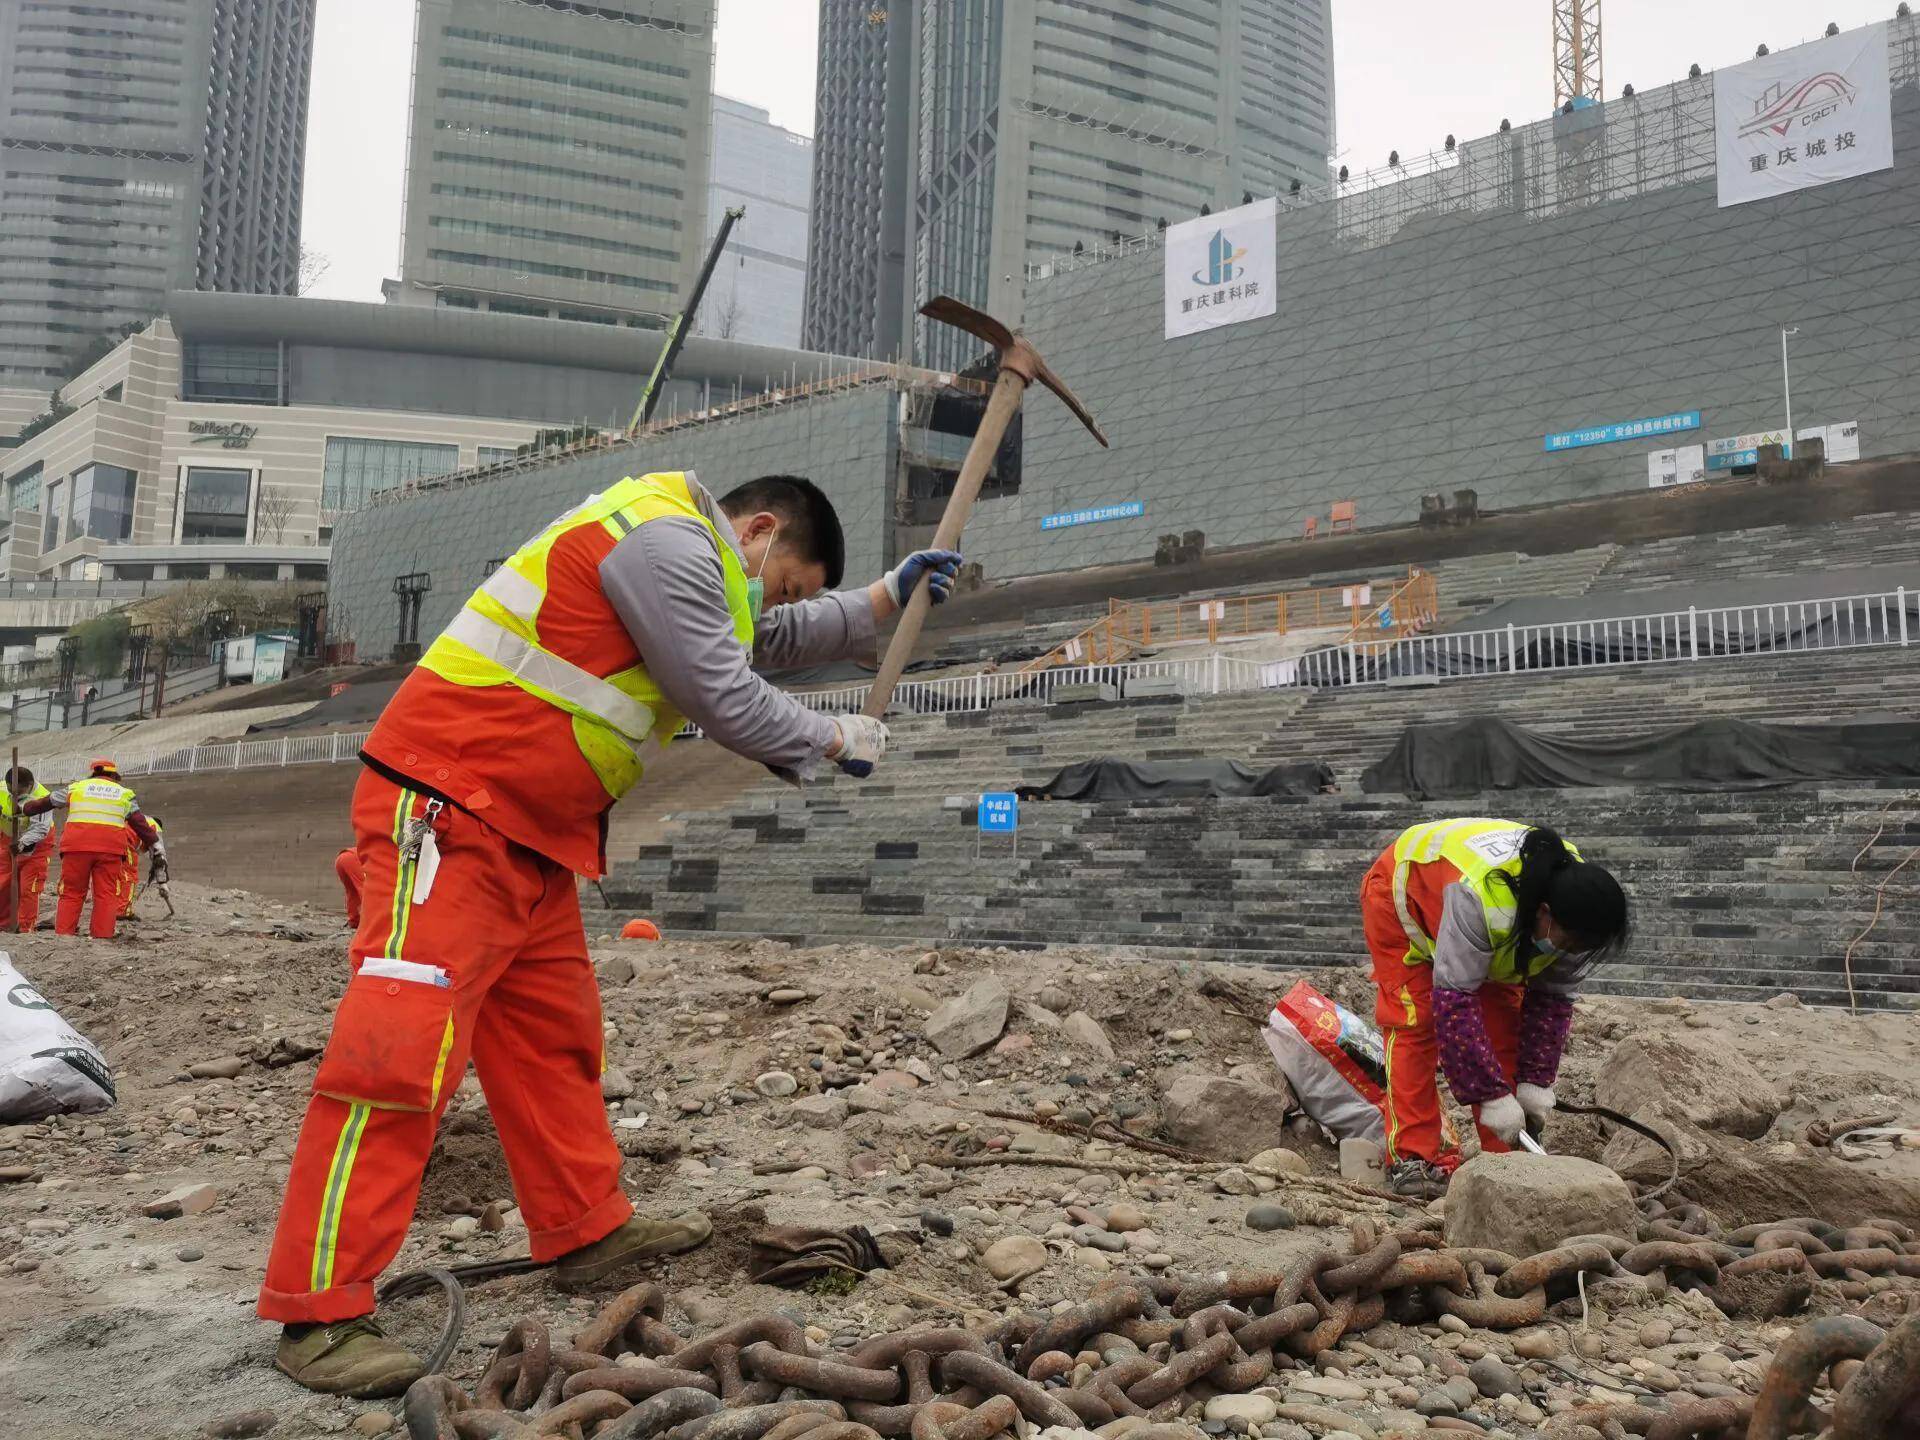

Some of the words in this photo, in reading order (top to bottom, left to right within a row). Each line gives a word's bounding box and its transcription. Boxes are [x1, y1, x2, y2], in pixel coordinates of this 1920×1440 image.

[1801, 103, 1838, 127] CQCT
[1749, 131, 1857, 173] 重庆城投
[1181, 282, 1260, 314] 重庆建科院
